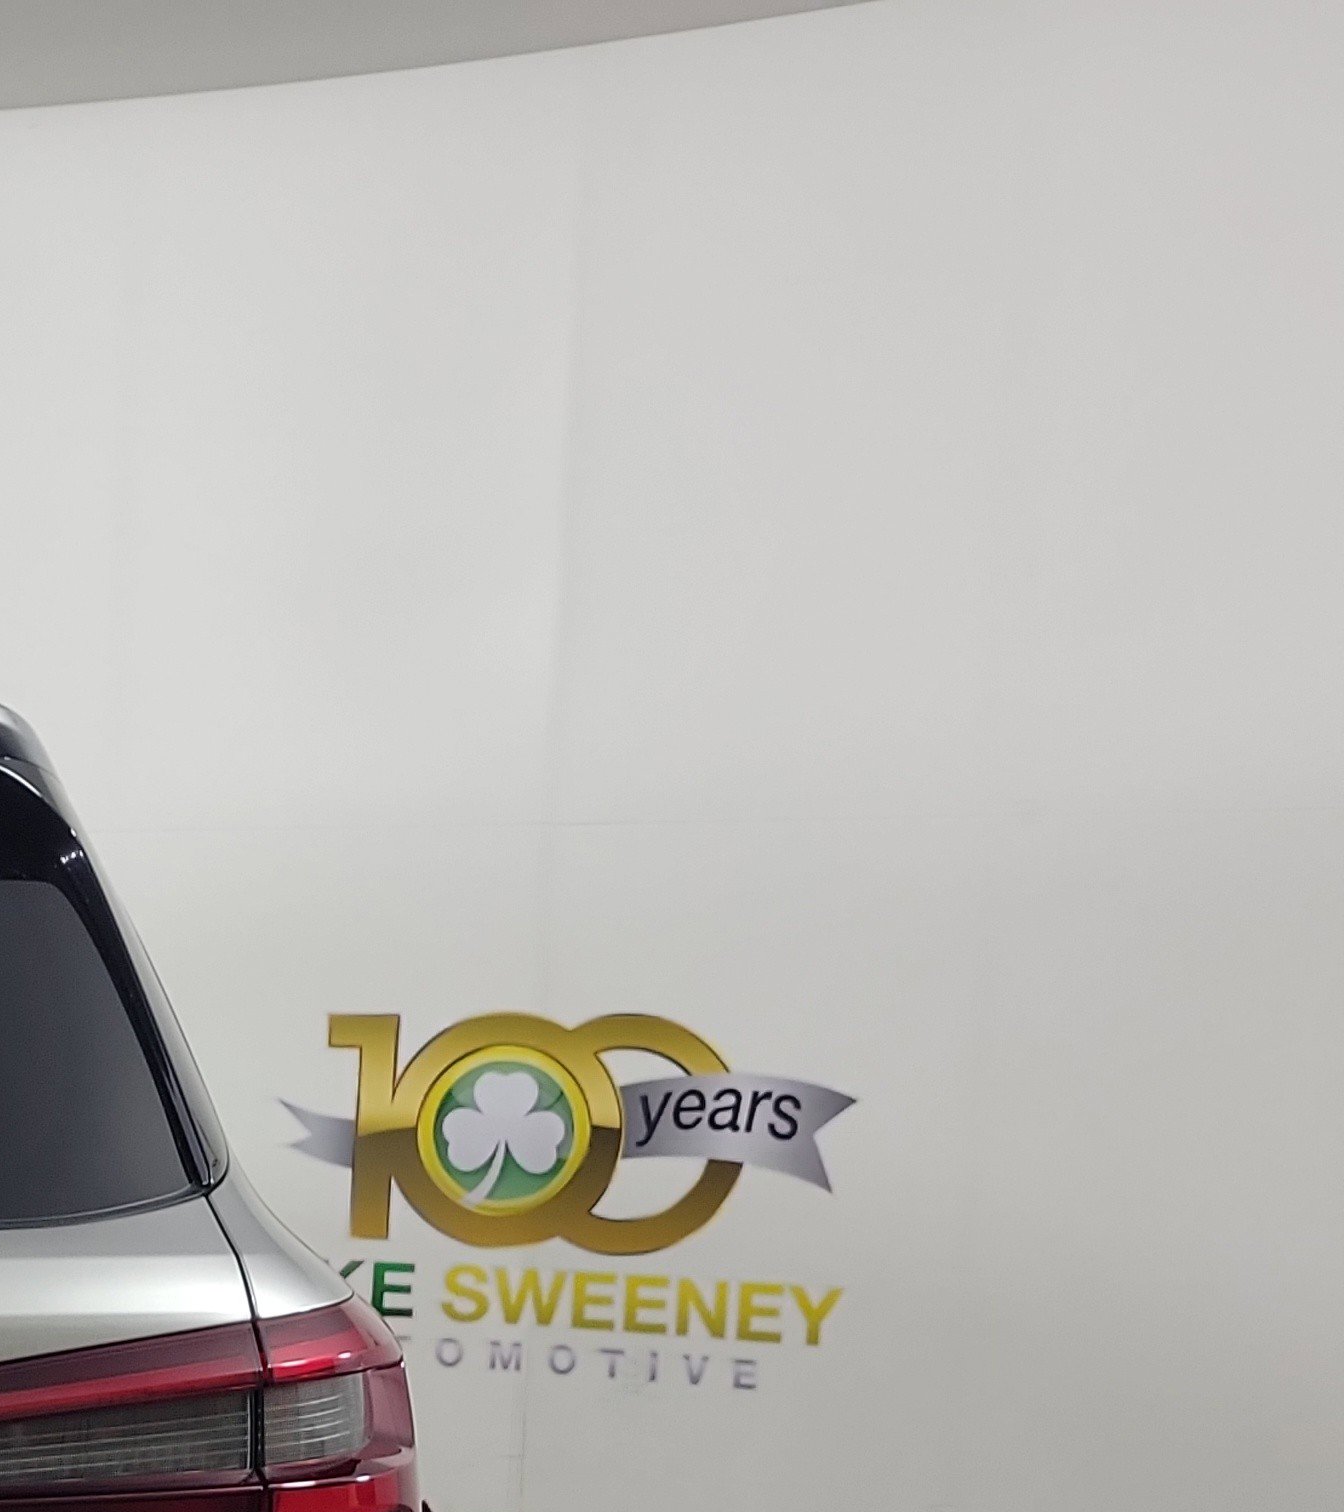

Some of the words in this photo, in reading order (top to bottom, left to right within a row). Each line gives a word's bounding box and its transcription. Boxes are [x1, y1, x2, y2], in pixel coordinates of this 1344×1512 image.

[635, 1086, 801, 1147] years
[339, 1260, 415, 1317] E
[441, 1262, 843, 1346] SWEENEY
[394, 1334, 758, 1390] OMOTIVE
